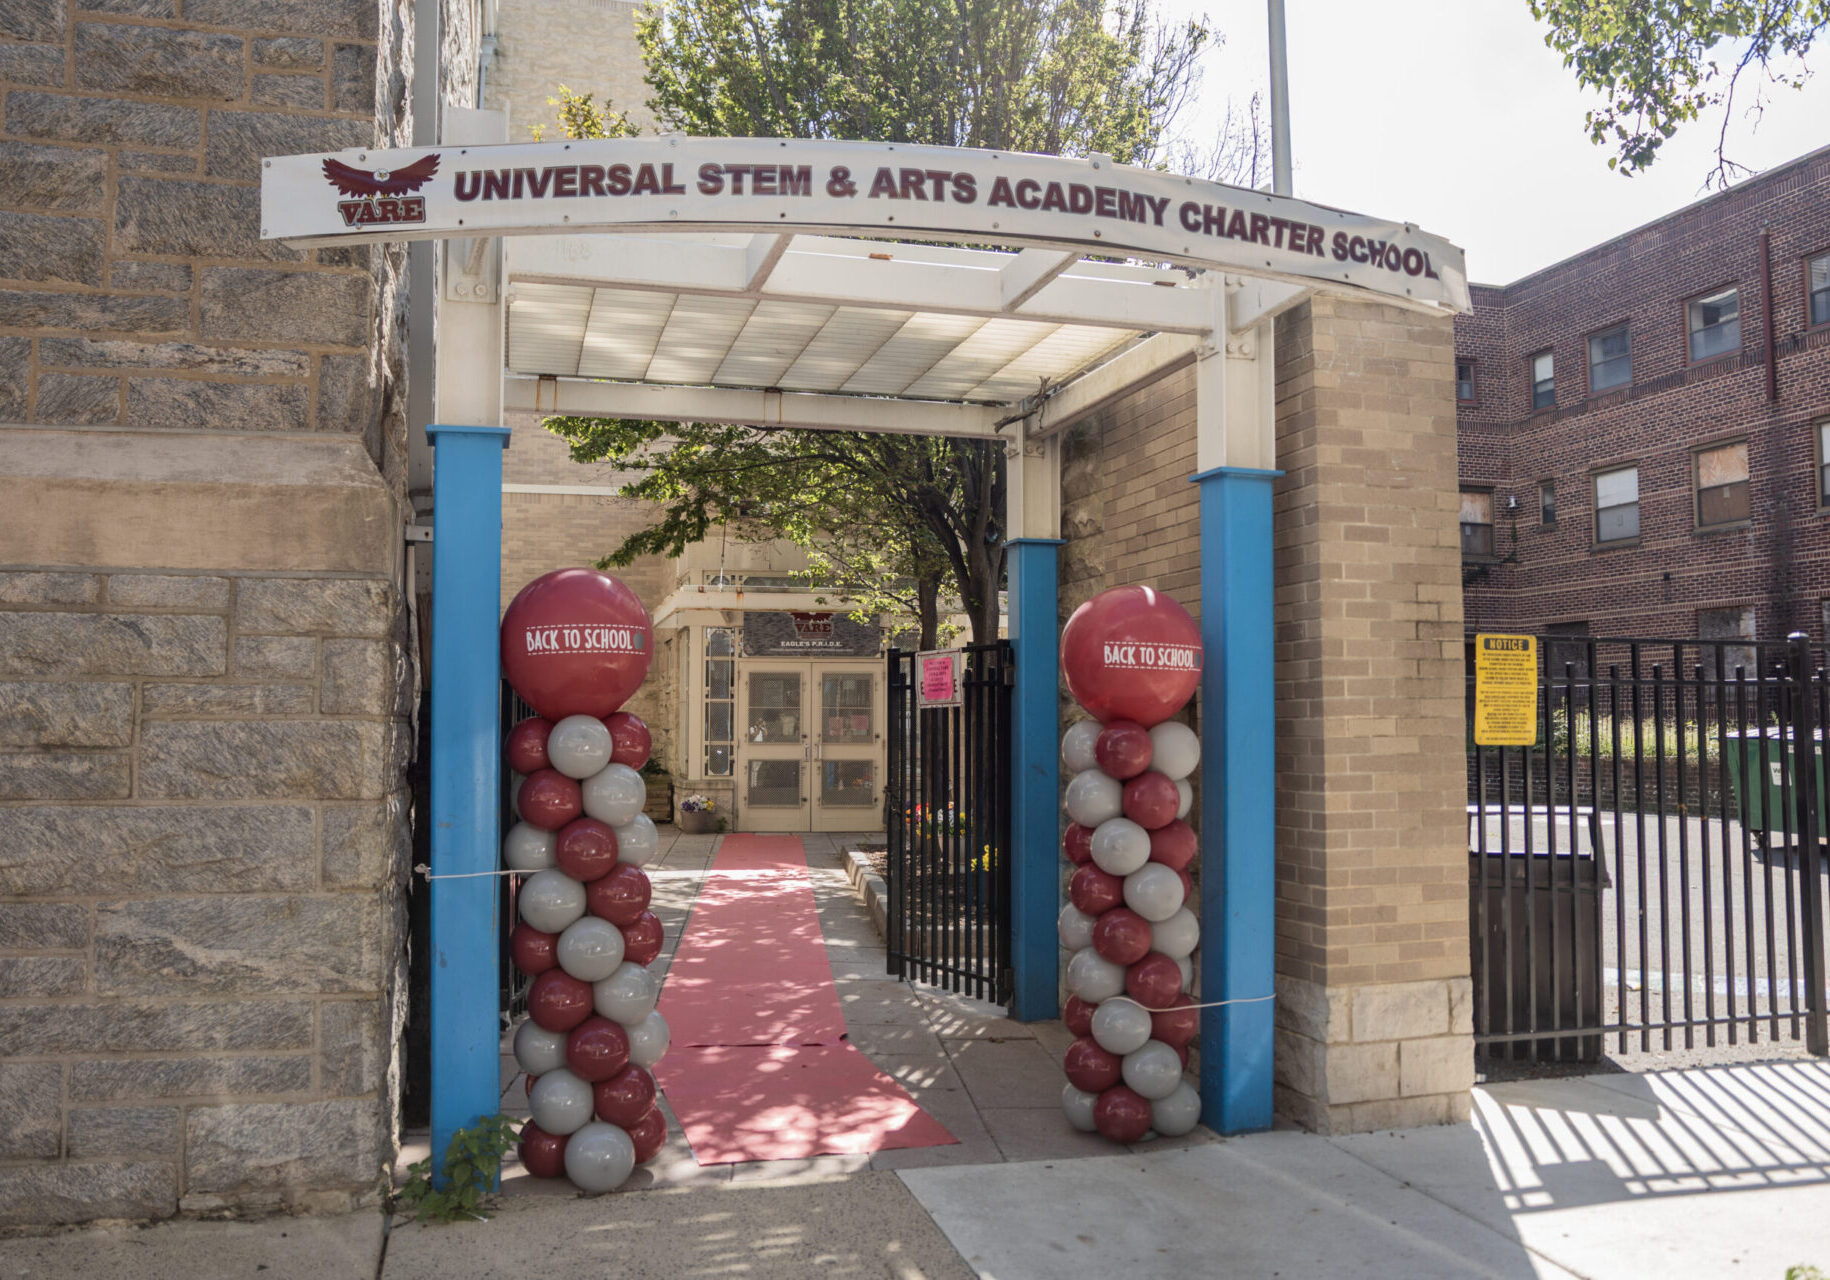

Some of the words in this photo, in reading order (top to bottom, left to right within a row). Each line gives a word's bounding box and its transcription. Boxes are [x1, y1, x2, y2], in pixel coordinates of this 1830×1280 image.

[338, 197, 426, 227] VARE
[454, 162, 686, 203] UNIVERSAL
[696, 162, 813, 197] STEM
[826, 166, 859, 198] &
[868, 167, 978, 205] ARTS
[987, 176, 1172, 228] ACADEMY
[1179, 201, 1327, 258] CHARTER
[1330, 231, 1440, 281] SCHOOL
[795, 623, 832, 633] VARE
[526, 629, 560, 652] BACK
[563, 629, 581, 649] TO
[584, 629, 633, 650] SCHOOL
[1489, 638, 1524, 650] NOTICE
[1104, 645, 1136, 665] BACK
[1139, 646, 1155, 666] TO
[1157, 648, 1195, 668] SCHOOL
